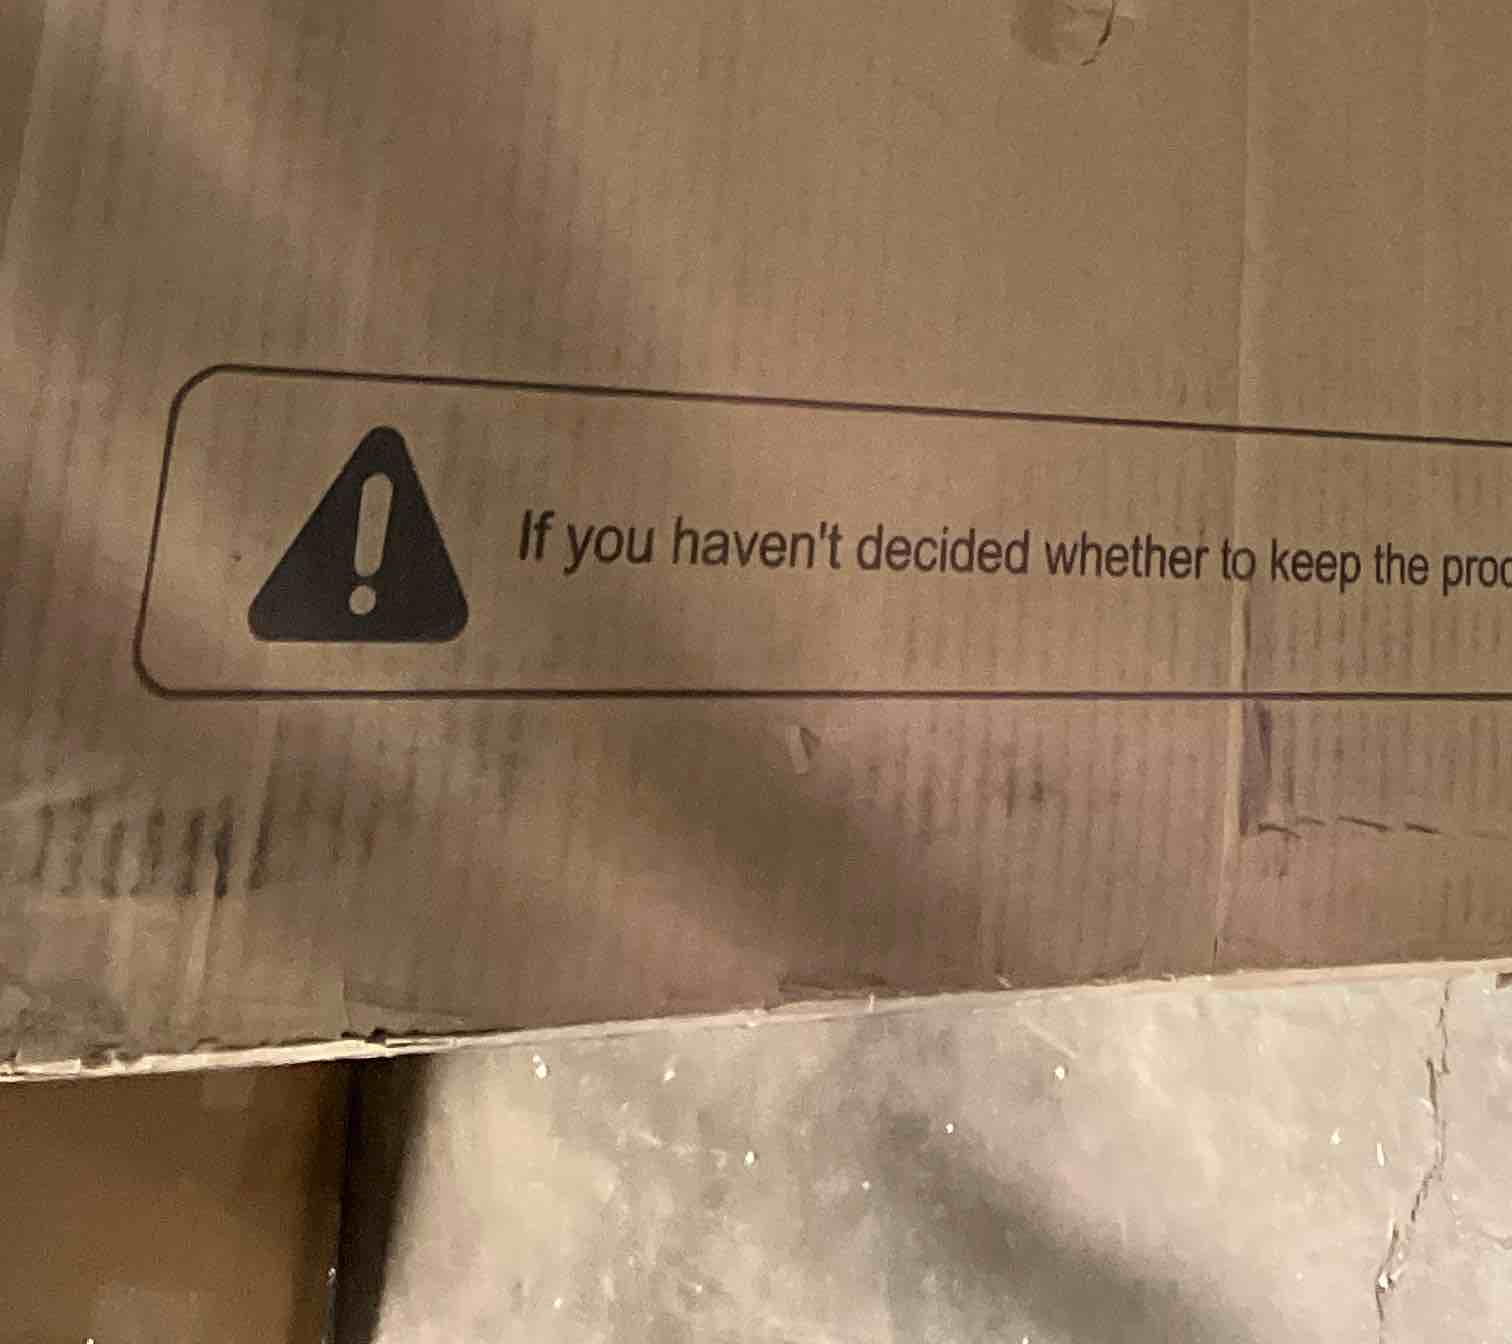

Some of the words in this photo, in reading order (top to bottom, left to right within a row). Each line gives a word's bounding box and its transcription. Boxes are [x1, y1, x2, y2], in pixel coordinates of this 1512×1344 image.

[519, 510, 555, 562] If
[563, 516, 655, 576] you
[672, 516, 843, 571] haven't
[857, 523, 1030, 575] decided
[1045, 529, 1210, 580] whether
[1220, 537, 1256, 580] to
[1270, 539, 1362, 587] keep
[1374, 543, 1430, 586] the
